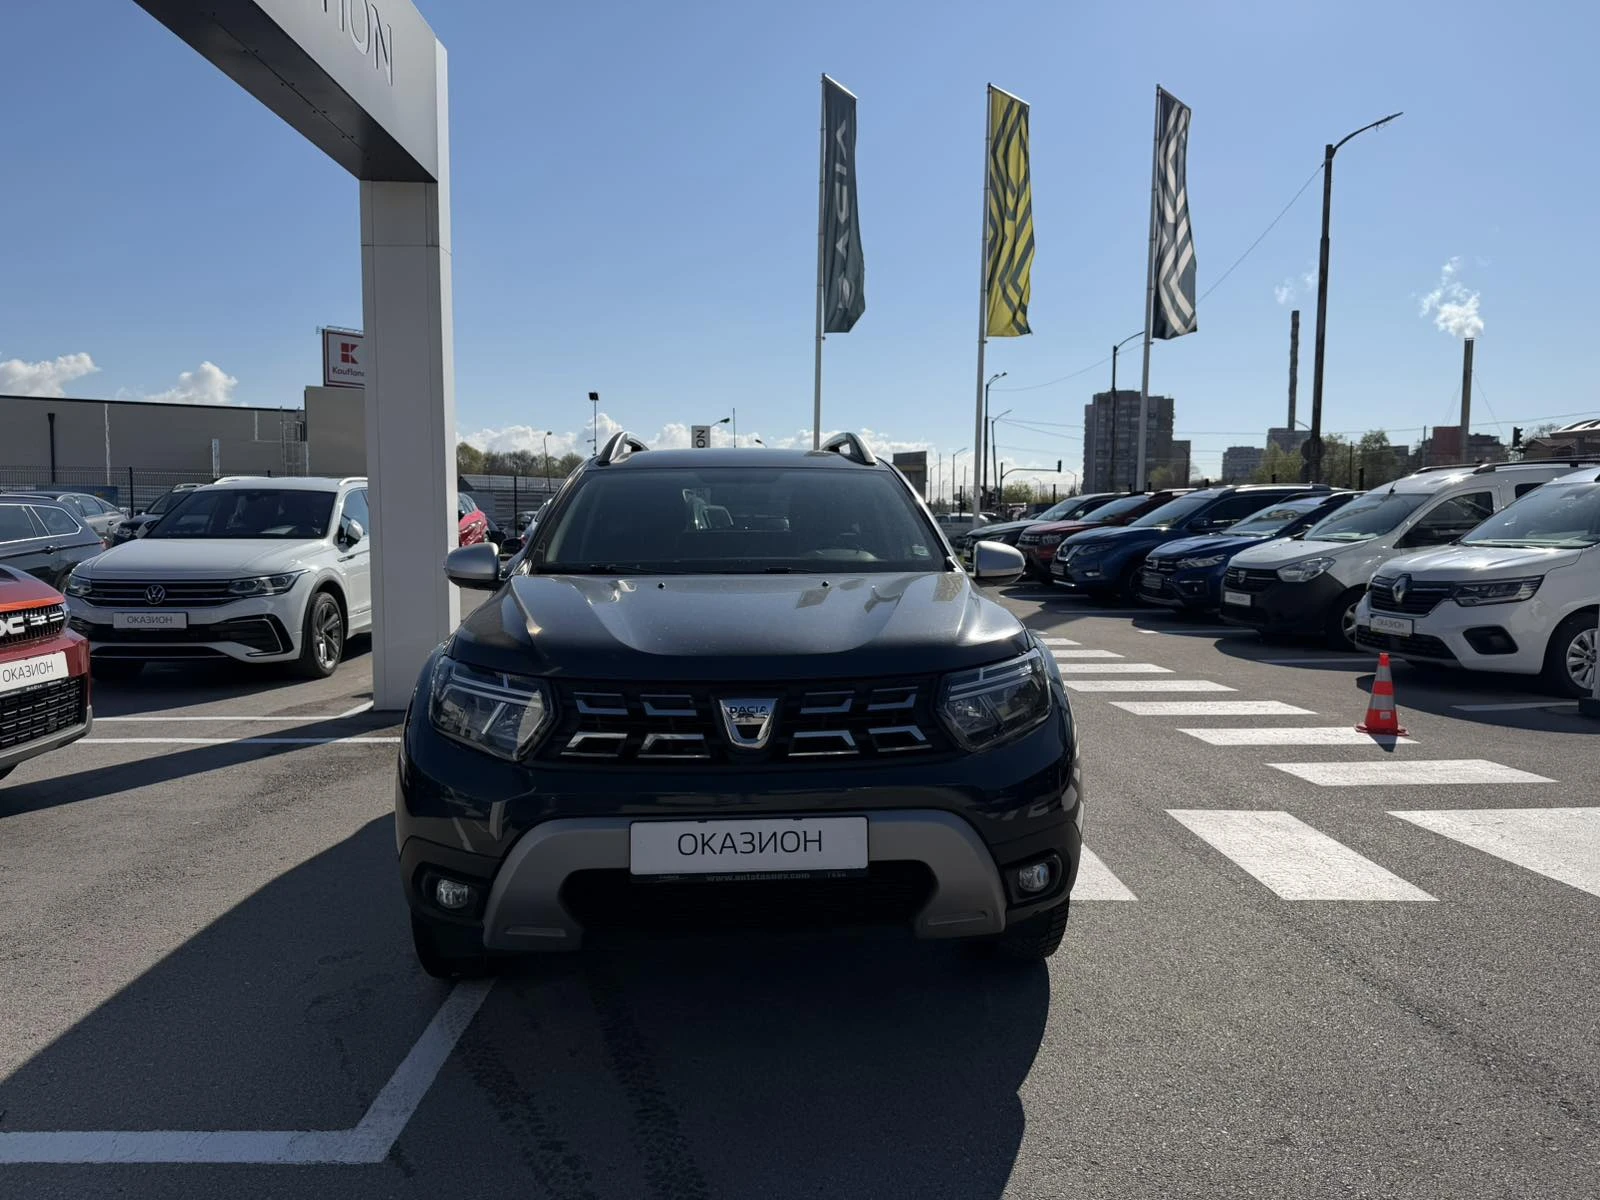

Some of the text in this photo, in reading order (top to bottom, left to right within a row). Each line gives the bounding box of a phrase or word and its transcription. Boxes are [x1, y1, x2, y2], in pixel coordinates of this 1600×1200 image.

[126, 615, 173, 624] ОКАЗИОН
[2, 659, 54, 683] ОКАЗИОН
[729, 705, 769, 714] DACIA
[677, 829, 822, 855] ОКАЗИОН
